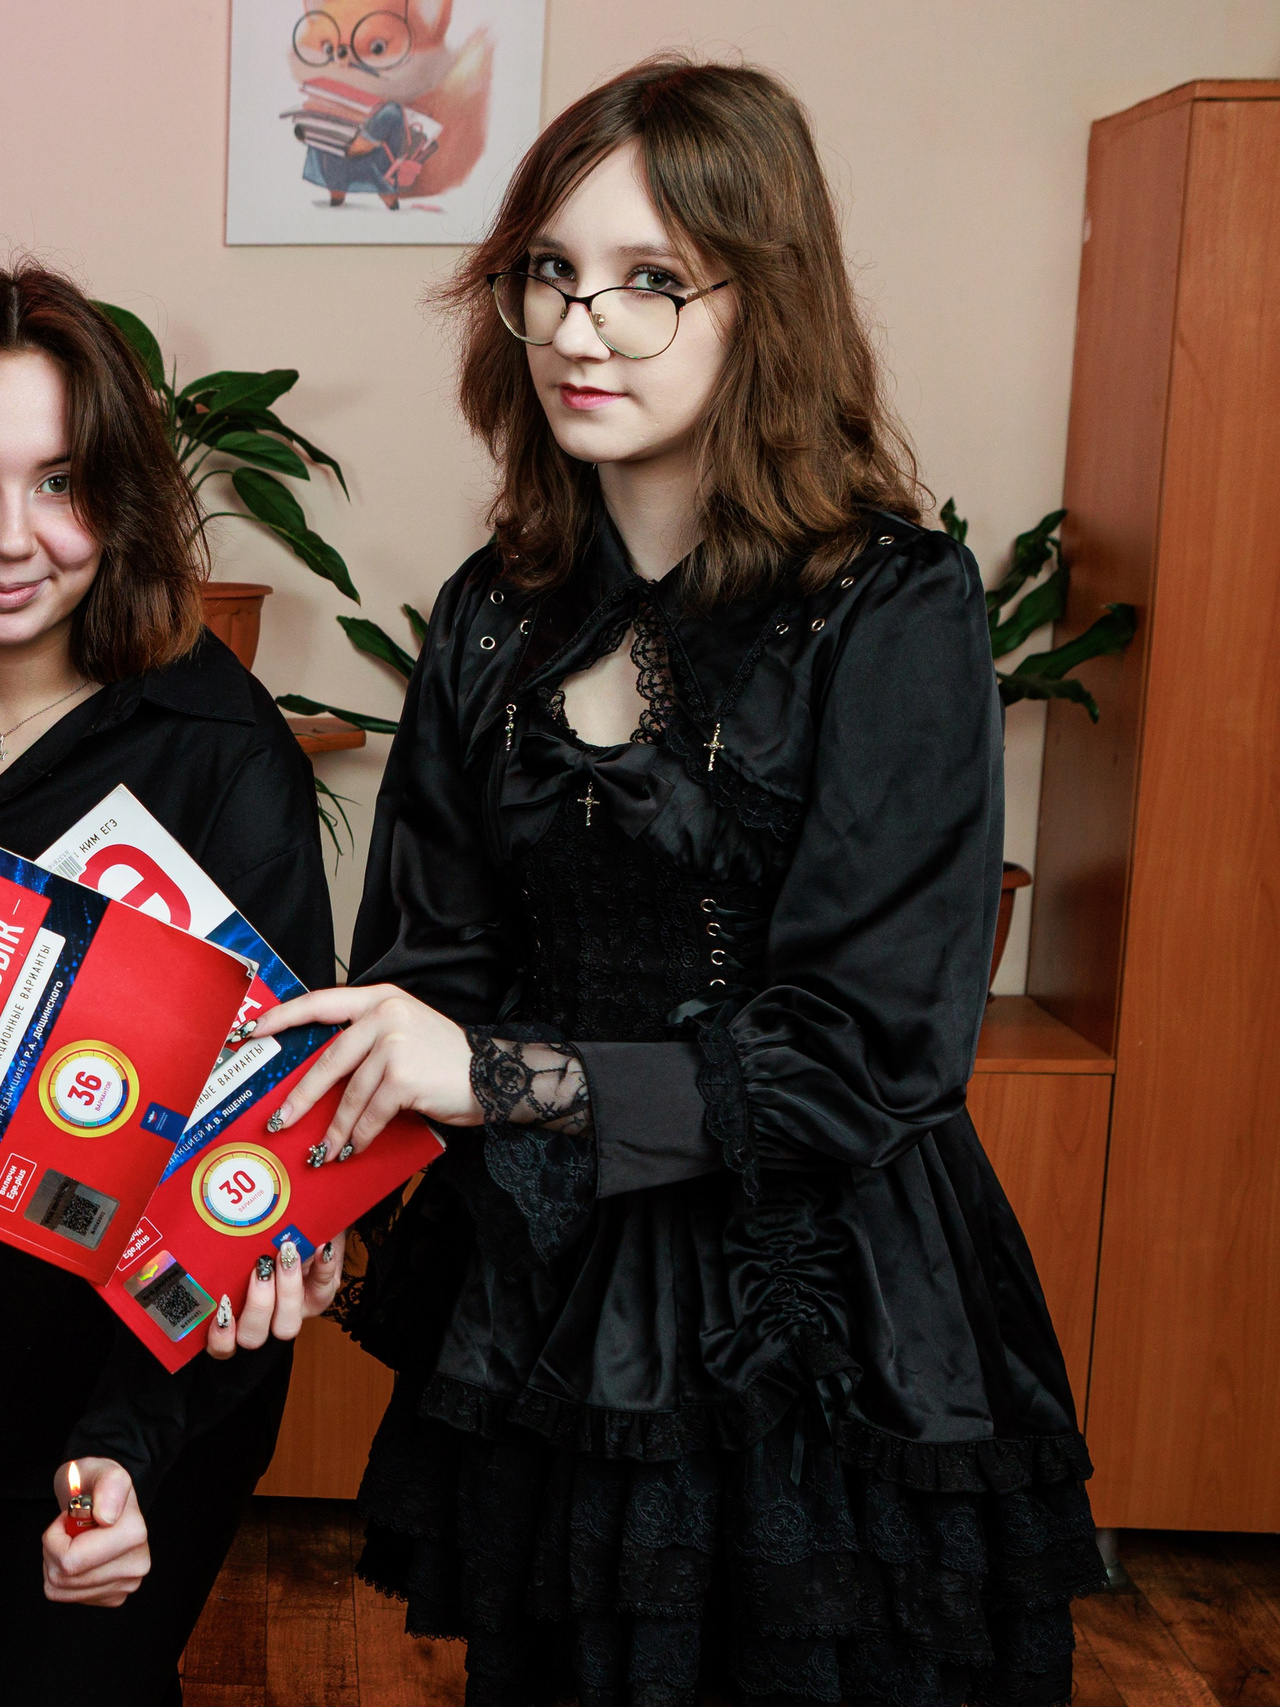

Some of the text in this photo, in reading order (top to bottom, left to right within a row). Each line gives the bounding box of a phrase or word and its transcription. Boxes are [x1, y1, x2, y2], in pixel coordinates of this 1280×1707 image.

[78, 816, 119, 854] КИМ ЕГЭ
[19, 943, 52, 1000] ВАРИАНТЫ
[31, 979, 65, 1040] ДОЩИНСКОГО
[216, 1042, 265, 1087] ВАРИАНТЫ
[68, 1072, 101, 1105] 36
[93, 1079, 113, 1112] ВАРИАНТОВ
[220, 1087, 254, 1119] ЯЩЕНКО
[5, 1166, 27, 1200] Ege.plus
[220, 1171, 255, 1204] 30
[236, 1187, 265, 1213] ВАРИАНТОВ
[121, 1233, 151, 1260] Ege.plus
